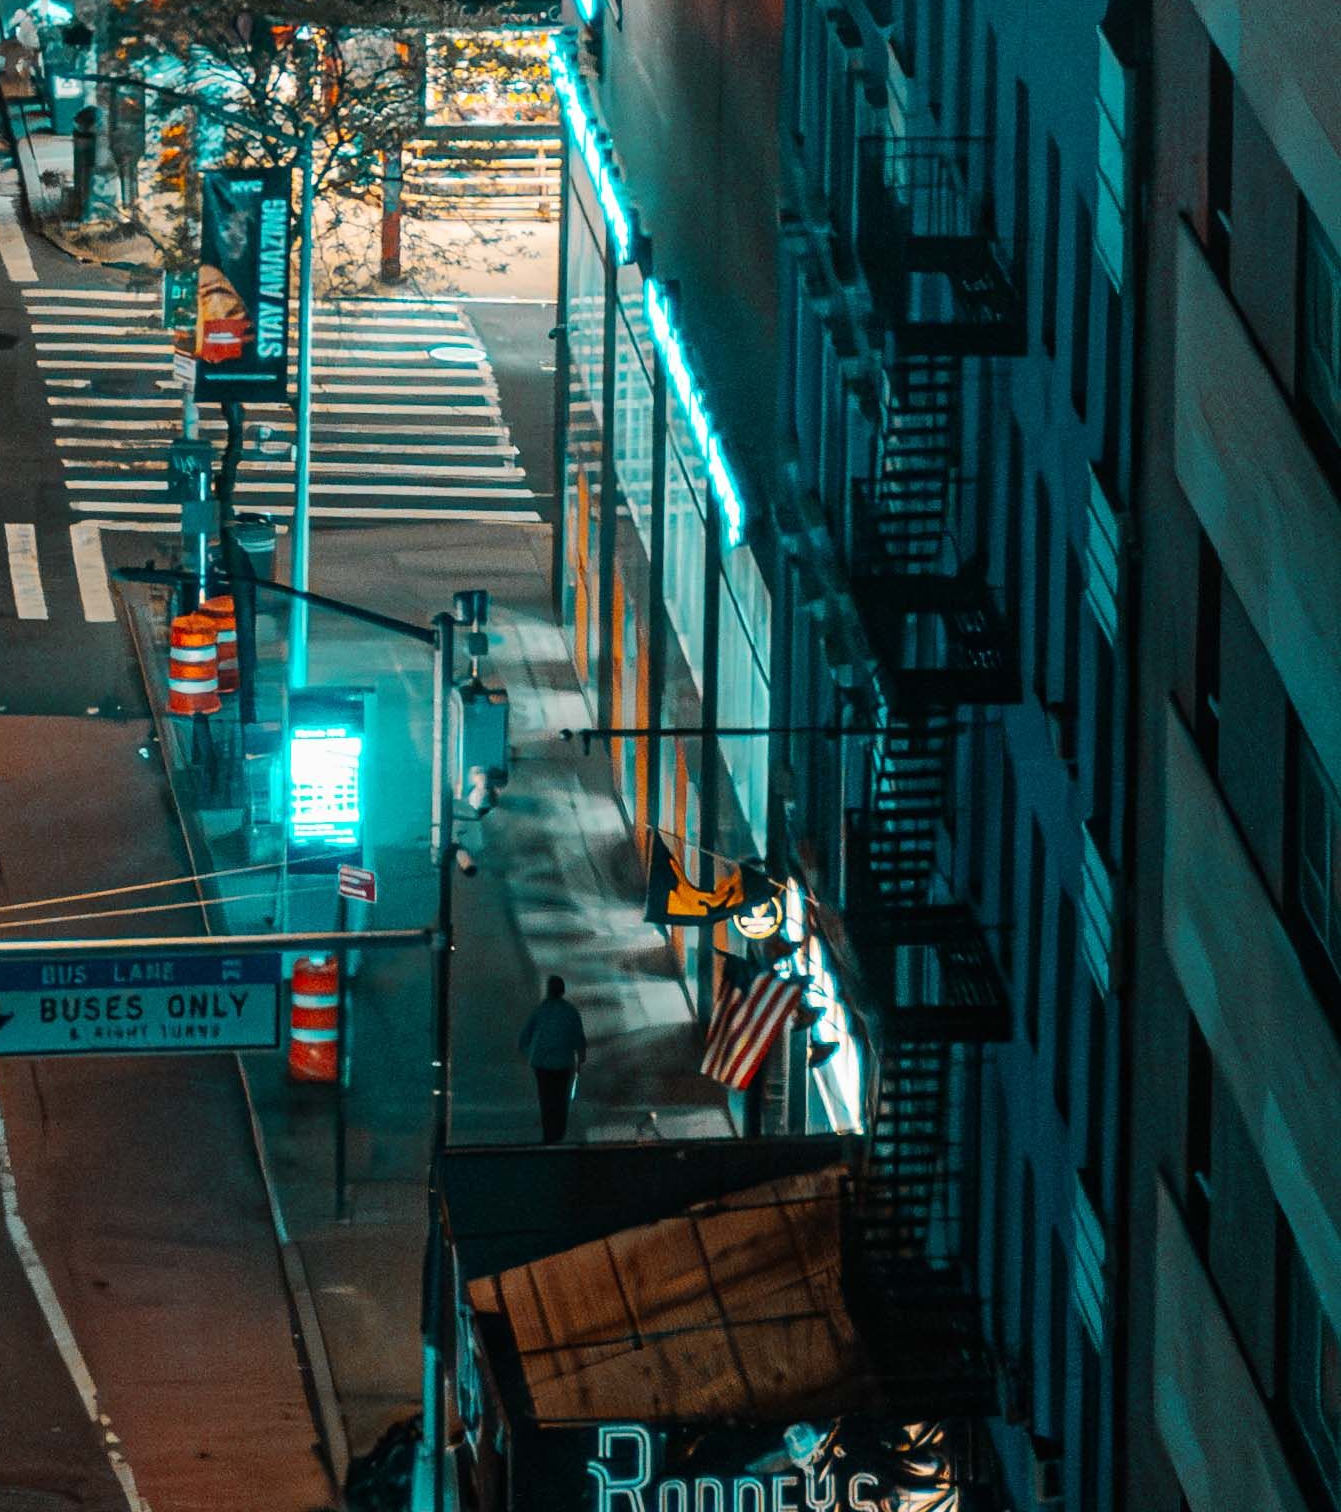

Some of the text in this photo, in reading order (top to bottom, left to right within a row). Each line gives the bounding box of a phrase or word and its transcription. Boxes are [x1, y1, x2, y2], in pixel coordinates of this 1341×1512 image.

[257, 199, 288, 358] STAY AMAZING
[41, 961, 174, 986] BUS LANE
[39, 991, 249, 1024] BUSES ONLY
